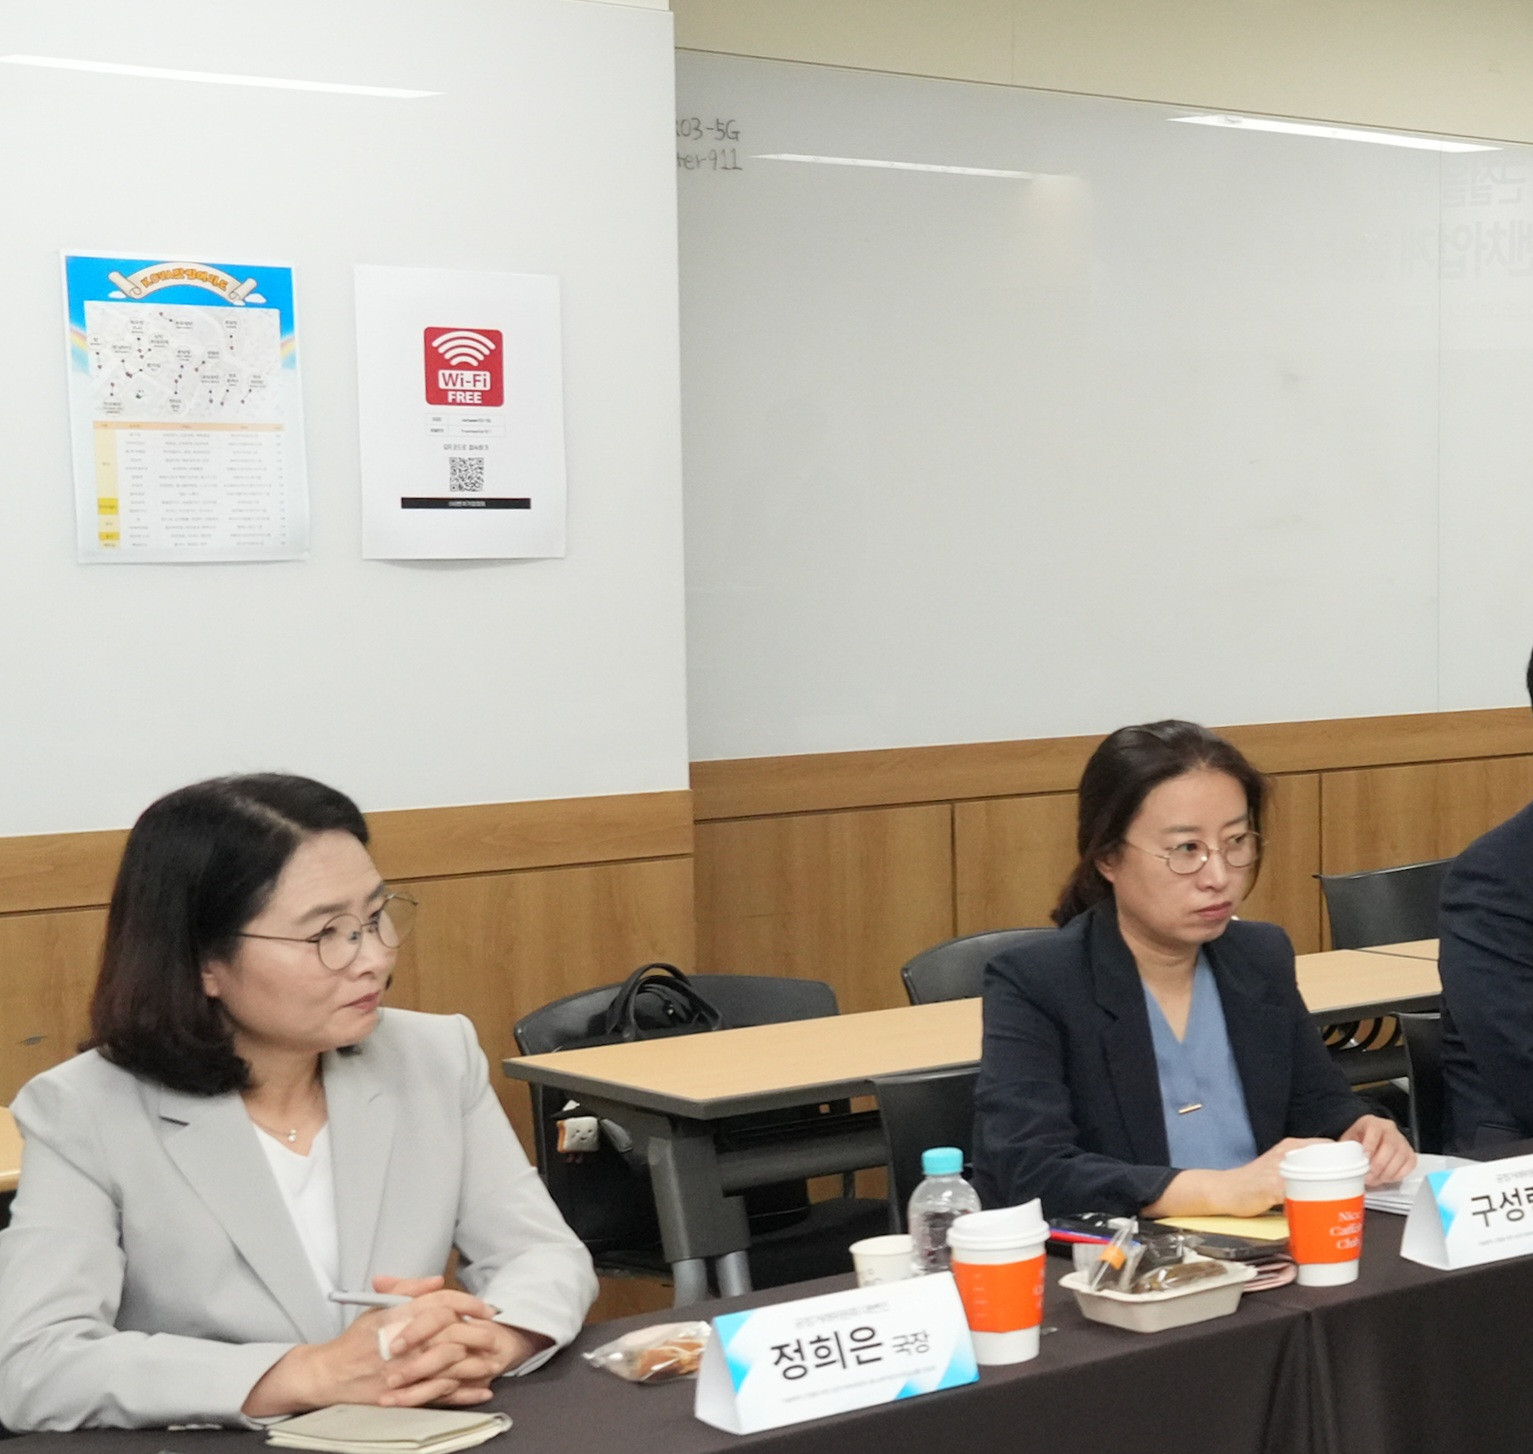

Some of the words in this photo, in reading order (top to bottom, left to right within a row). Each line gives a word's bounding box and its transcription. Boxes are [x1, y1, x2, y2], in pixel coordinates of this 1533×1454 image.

[441, 372, 488, 388] Wi-Fi
[447, 391, 482, 404] FREE
[770, 1326, 883, 1381] 정희은
[892, 1330, 931, 1356] 국장
